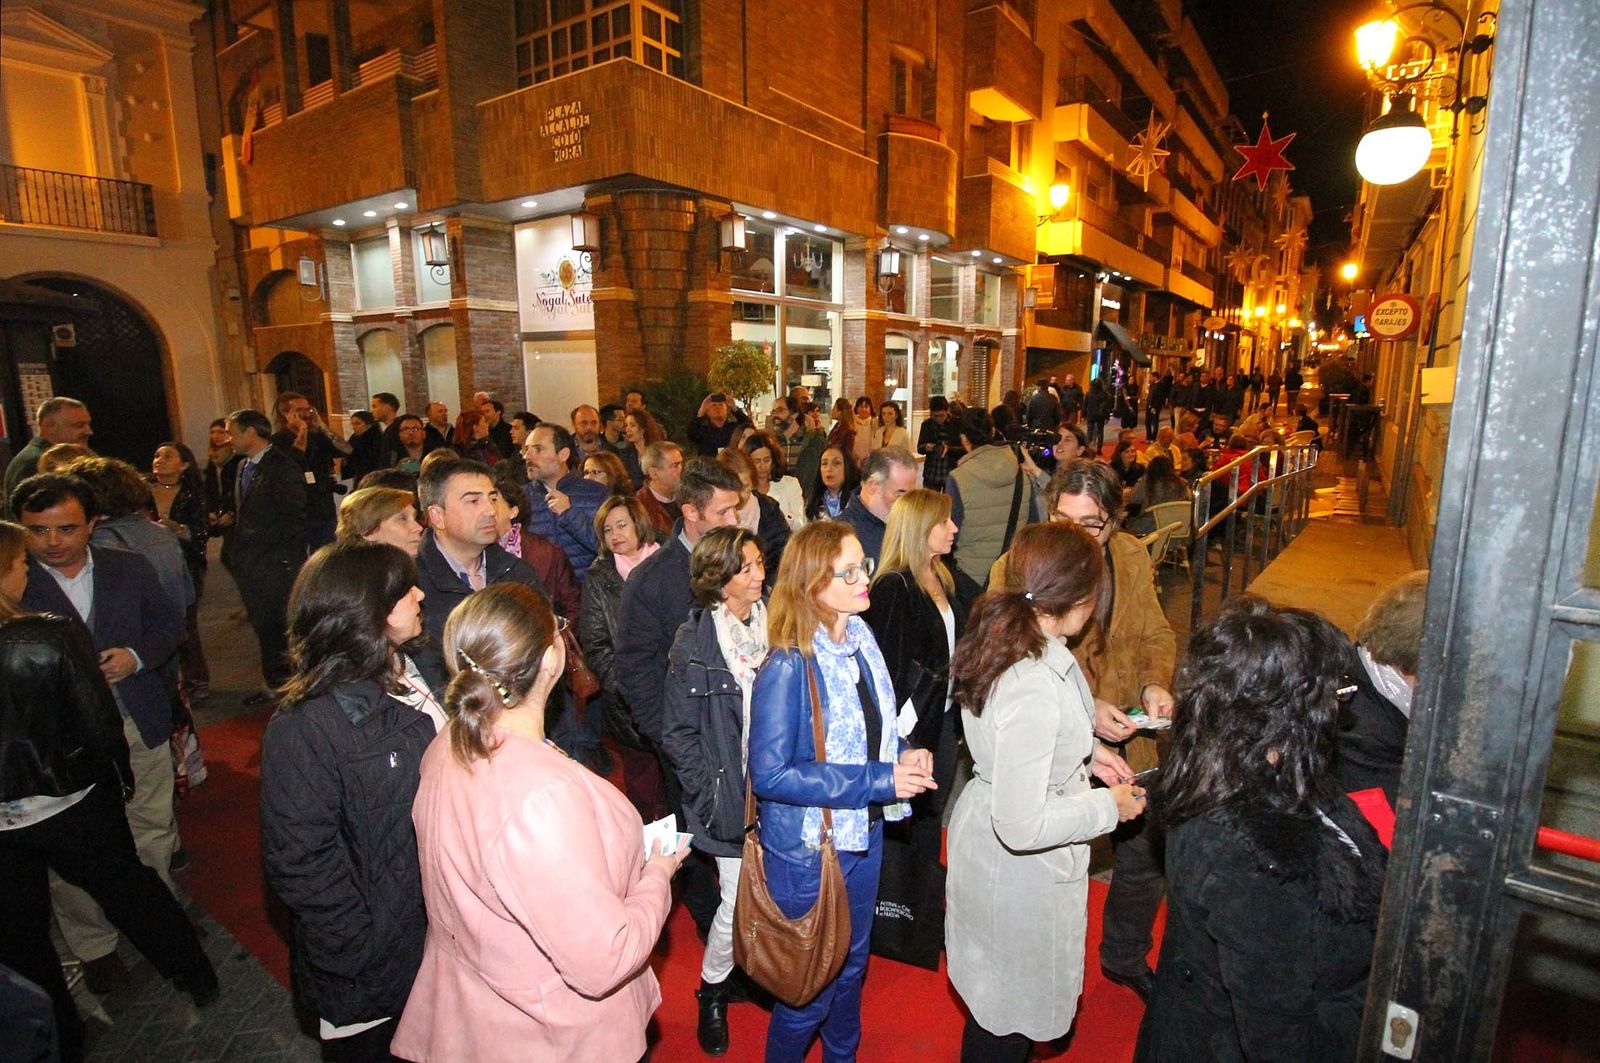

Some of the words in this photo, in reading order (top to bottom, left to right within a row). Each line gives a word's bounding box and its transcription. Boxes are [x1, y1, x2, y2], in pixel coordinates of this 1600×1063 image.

[545, 101, 582, 121] PLAZA
[540, 114, 590, 137] ALCALDE
[551, 130, 581, 149] COTO
[553, 145, 583, 163] MORA
[532, 290, 565, 312] Nogal
